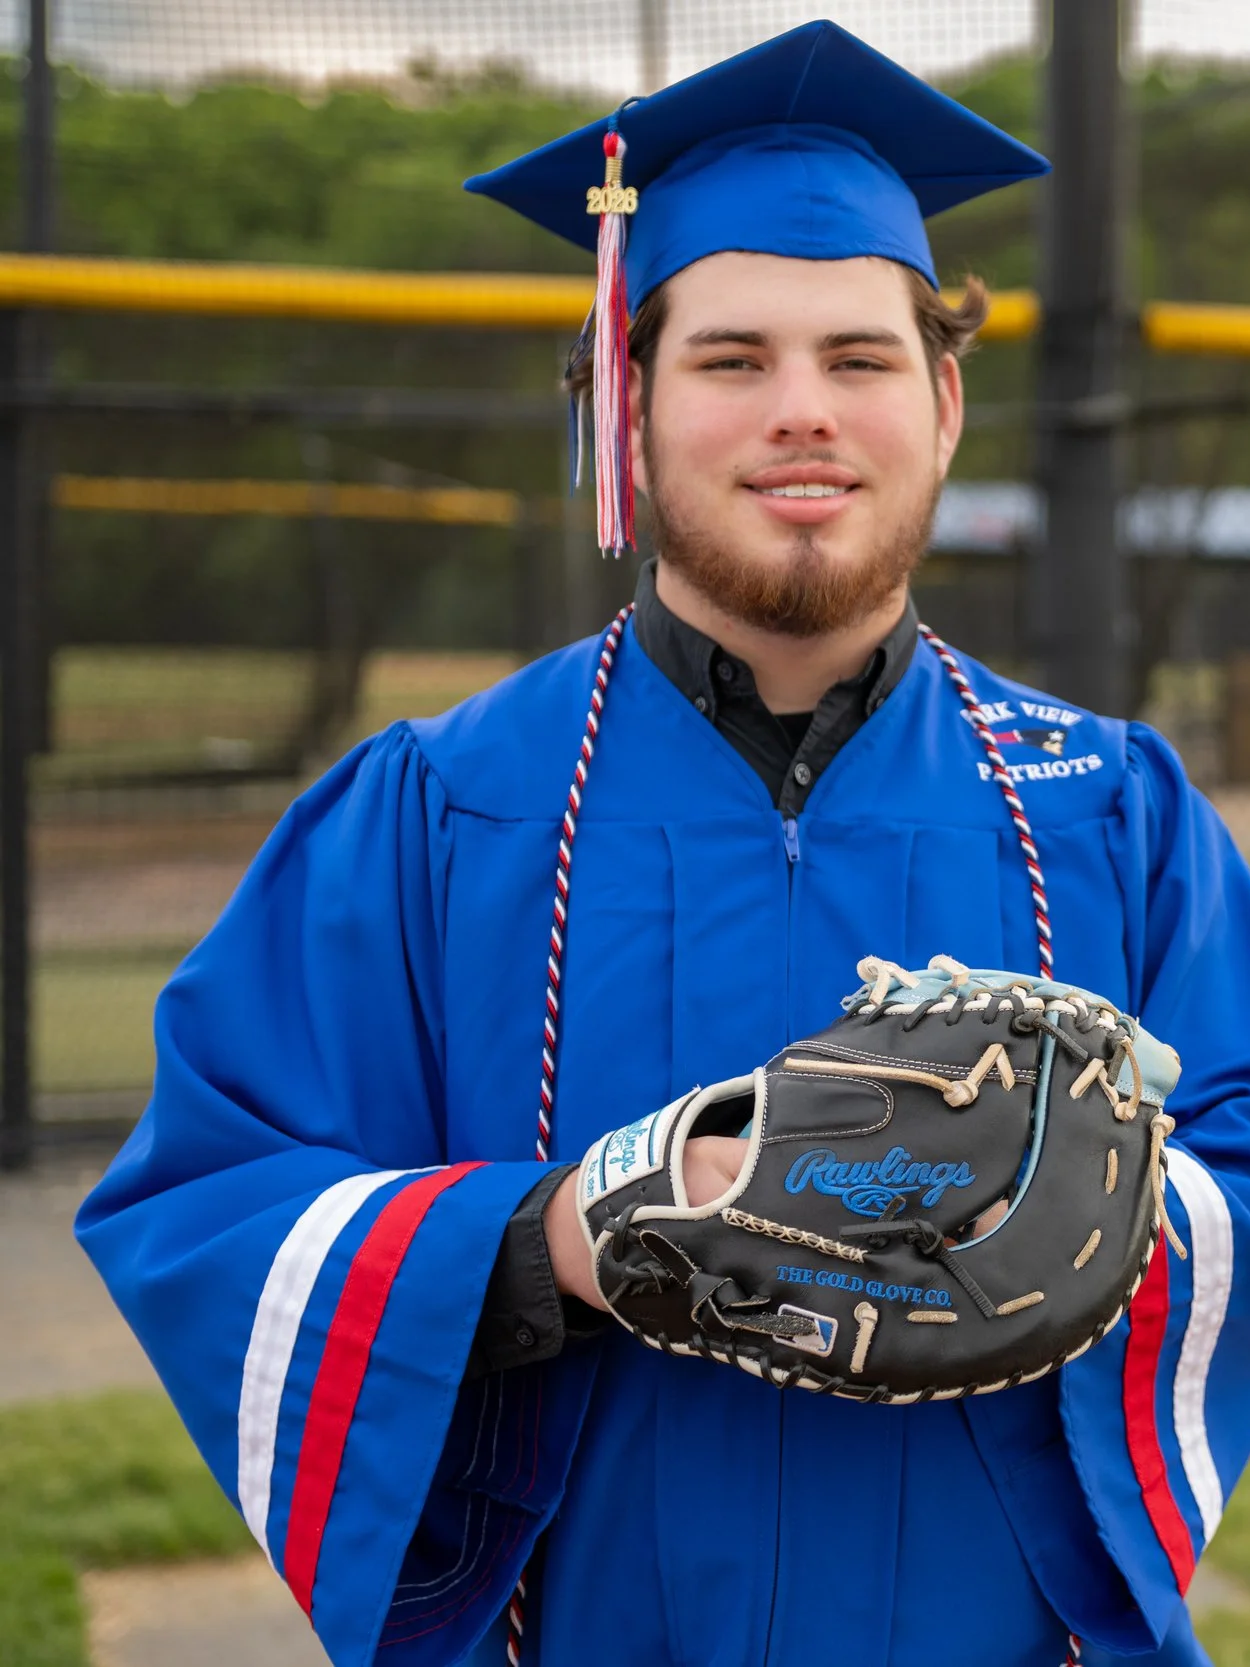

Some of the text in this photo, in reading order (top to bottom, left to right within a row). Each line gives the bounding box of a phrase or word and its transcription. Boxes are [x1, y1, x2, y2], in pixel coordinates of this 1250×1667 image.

[586, 186, 638, 214] 2026
[960, 701, 1083, 729] RK VIEW
[977, 754, 1103, 782] PTRIOTS
[784, 1146, 976, 1208] Rawlings
[776, 1265, 952, 1307] THE GOLD GLOVE CO.
